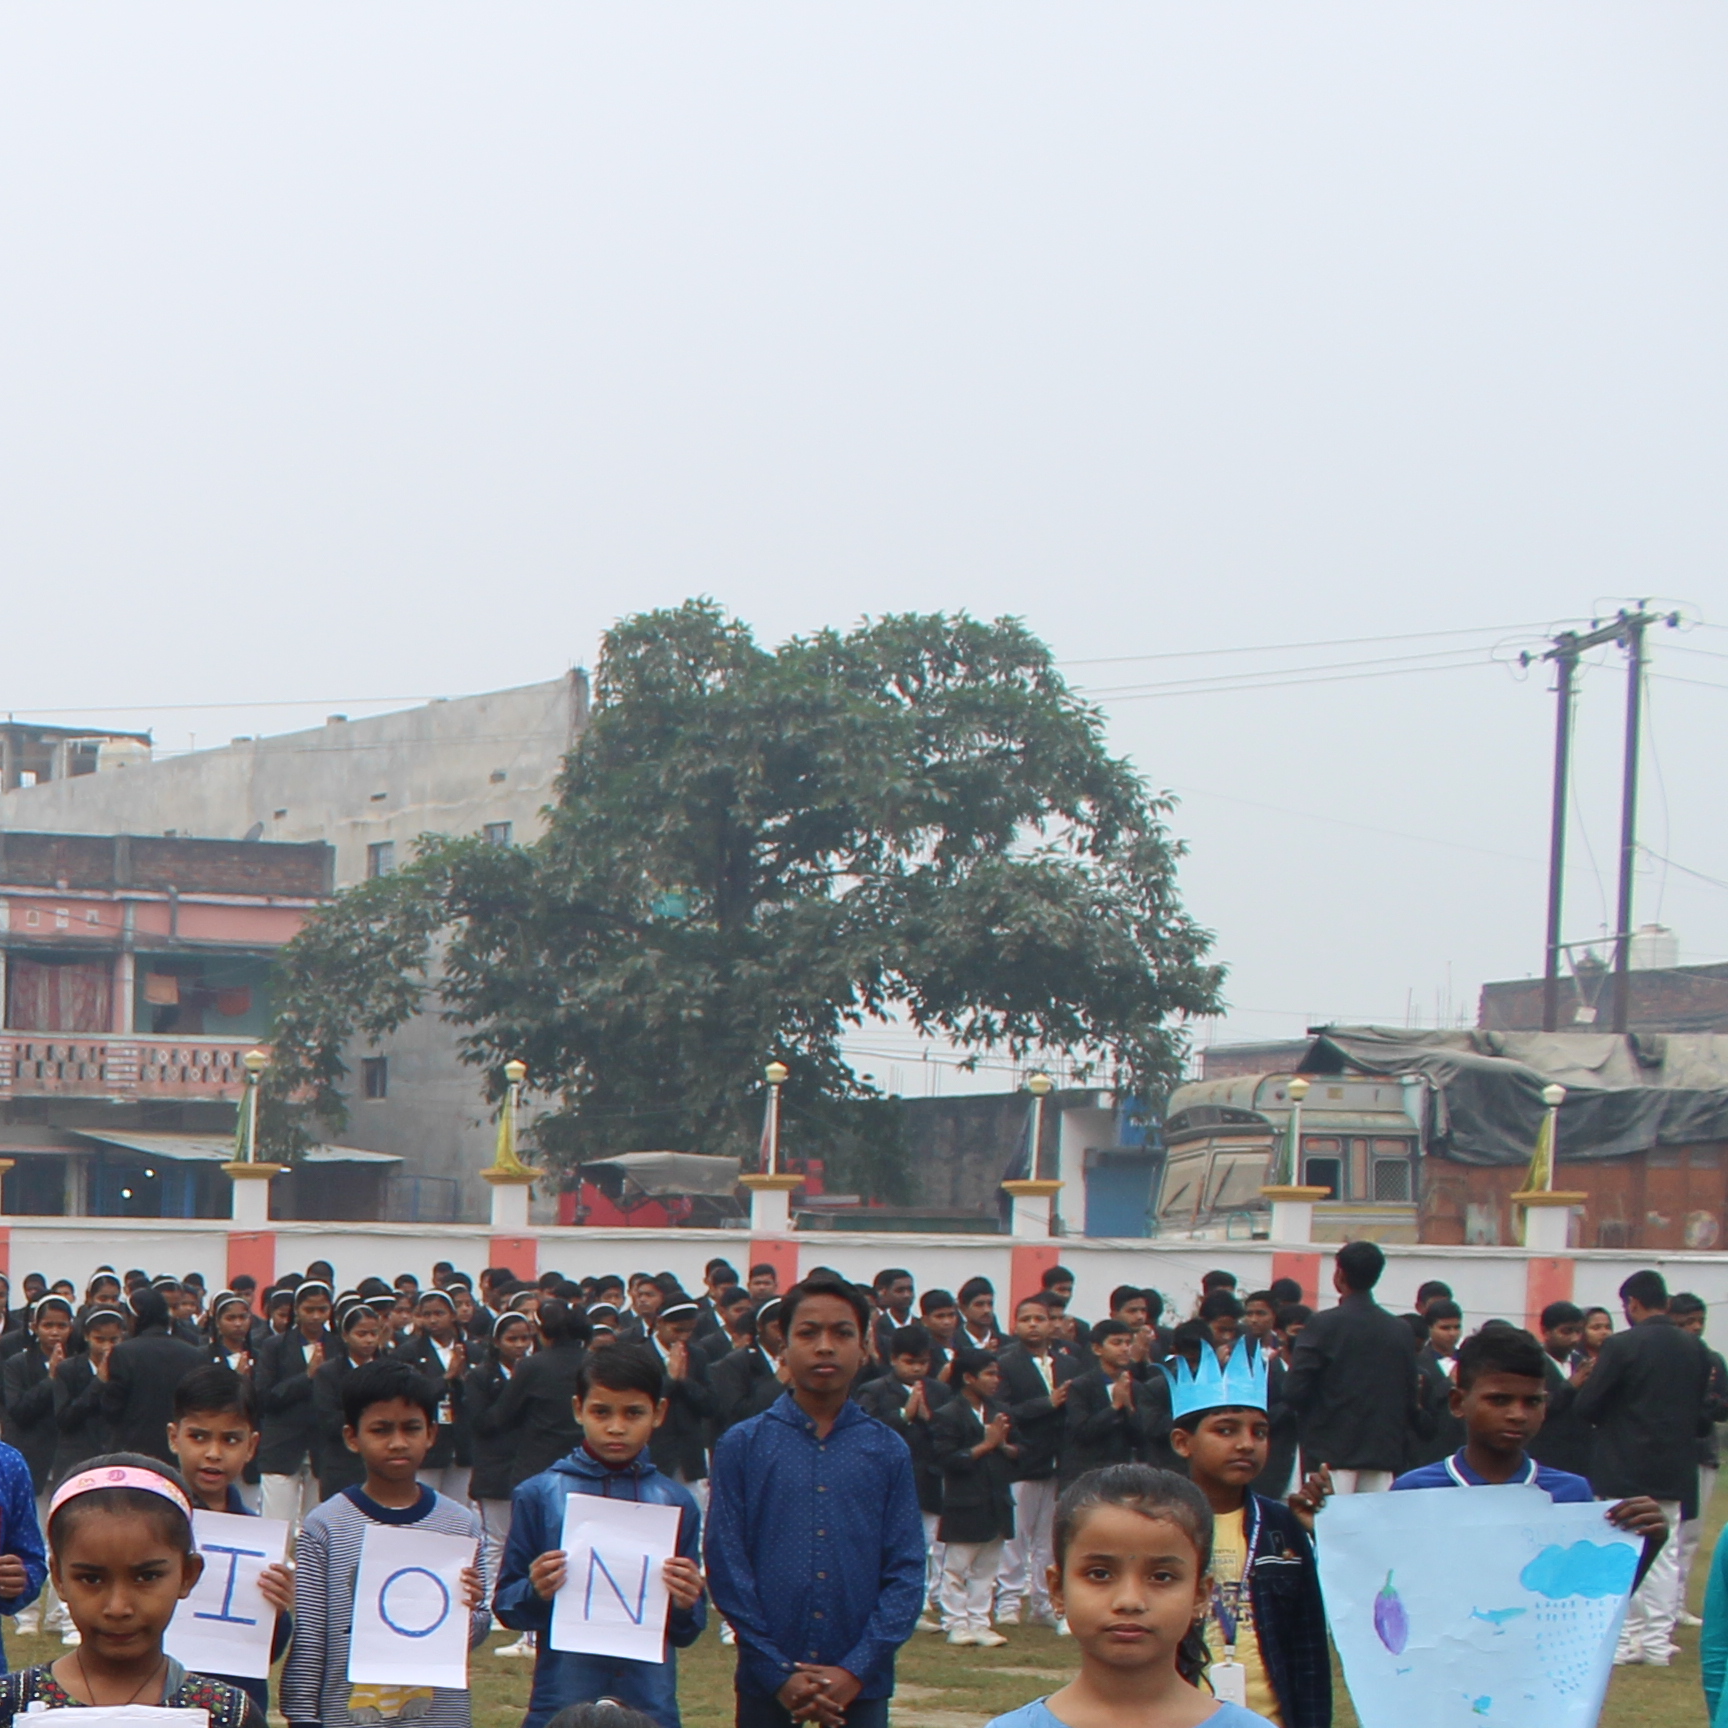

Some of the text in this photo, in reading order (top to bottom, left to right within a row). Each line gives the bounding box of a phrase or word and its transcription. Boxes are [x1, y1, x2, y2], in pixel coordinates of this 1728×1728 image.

[193, 1545, 266, 1625] I
[379, 1566, 451, 1638] O
[584, 1547, 648, 1625] N
